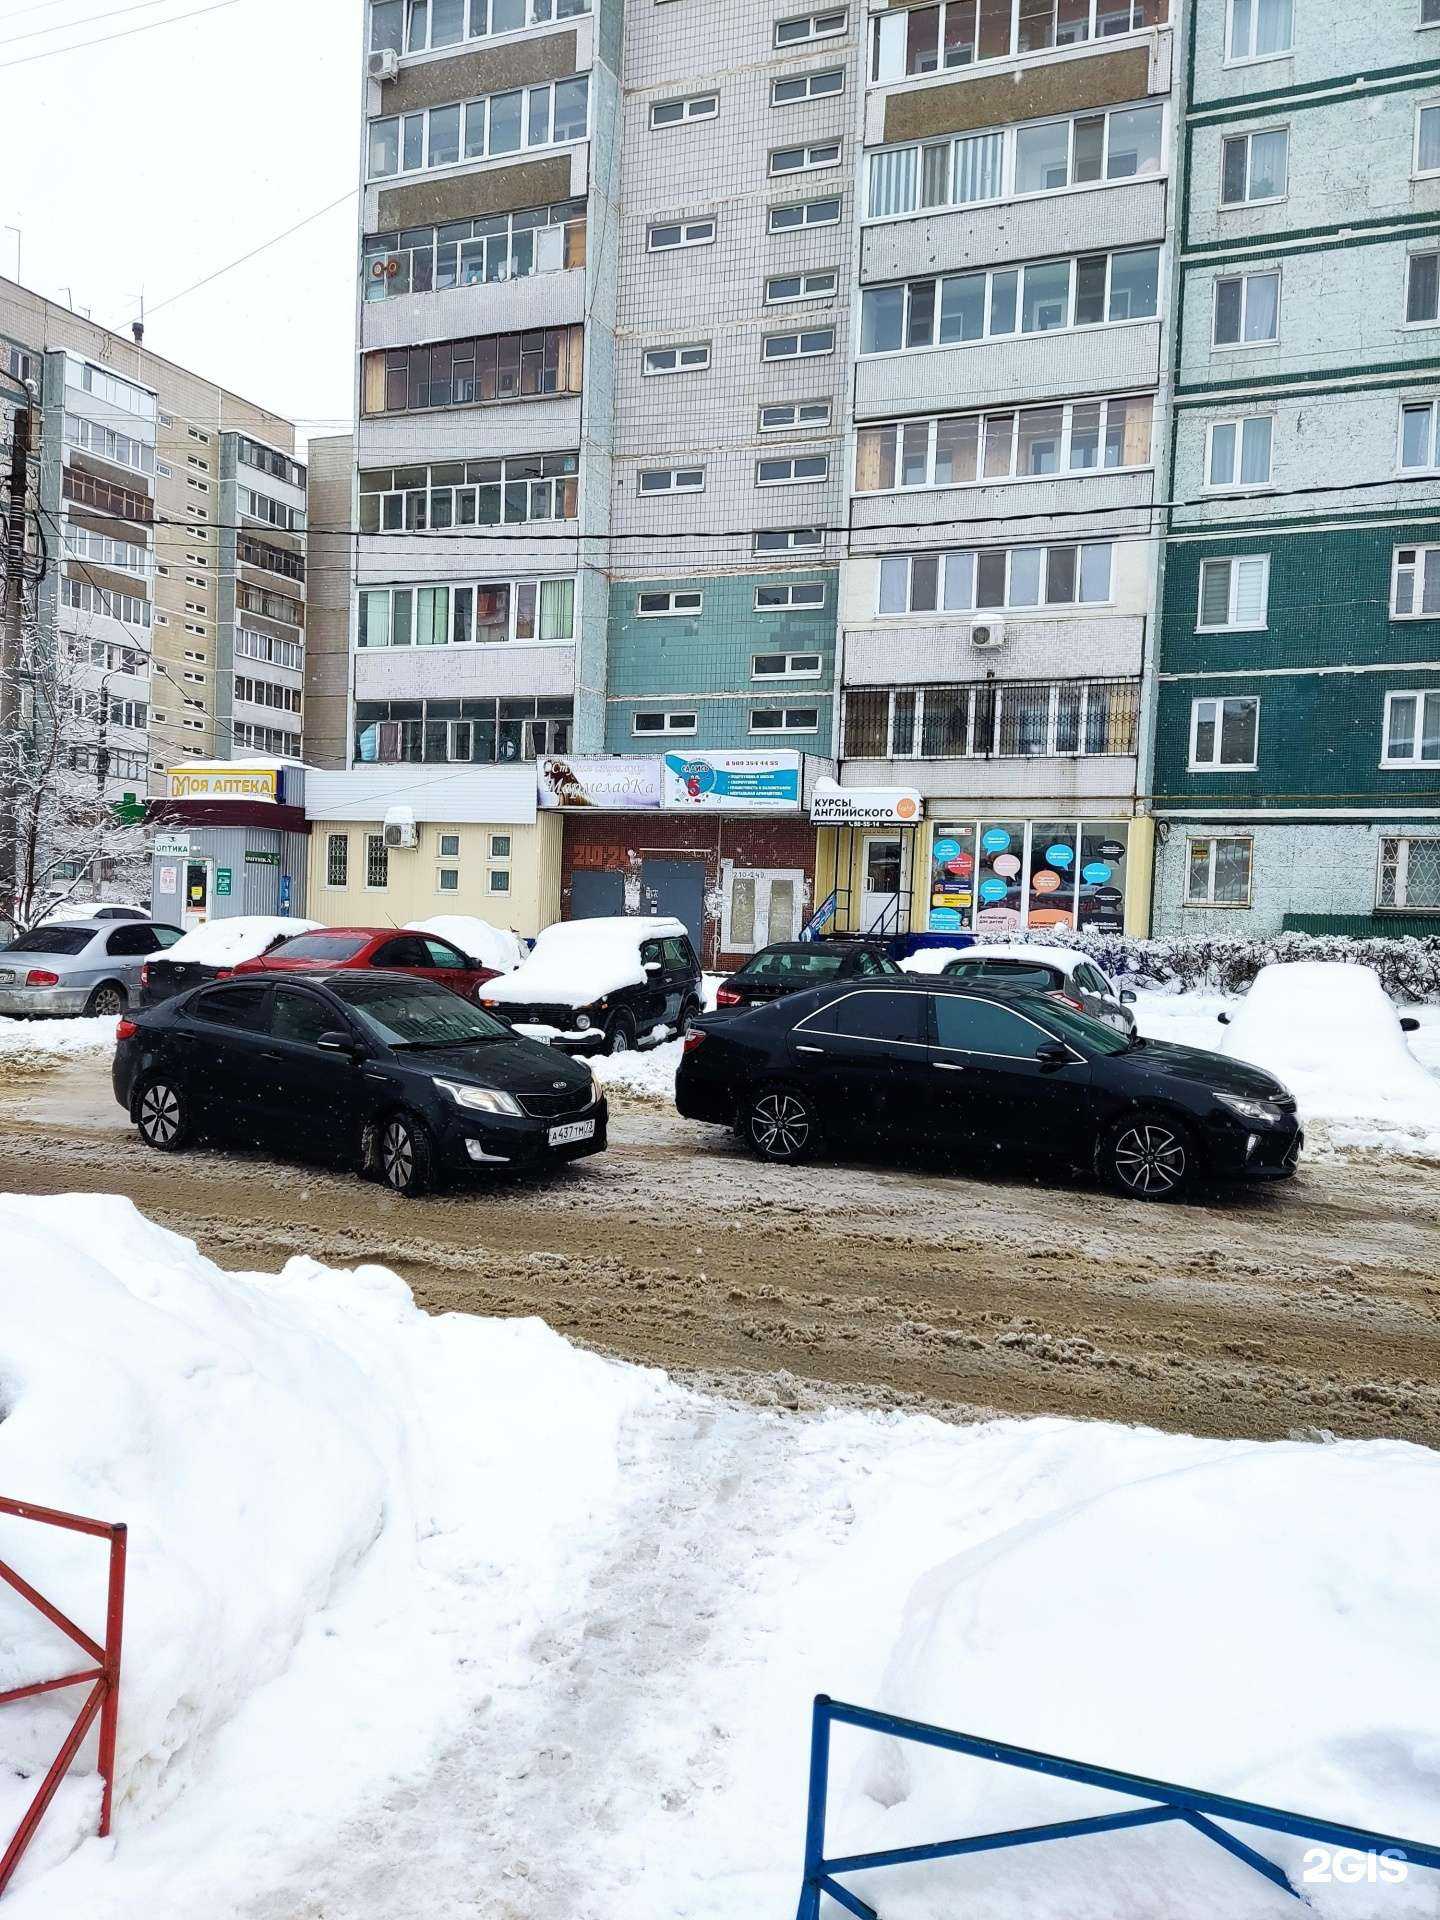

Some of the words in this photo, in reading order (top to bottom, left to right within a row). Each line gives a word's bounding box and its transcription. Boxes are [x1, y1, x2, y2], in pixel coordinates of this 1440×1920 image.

[172, 776, 209, 797] МОЯ
[213, 779, 270, 793] АПТЕКА
[814, 798, 852, 807] КУРСЫ
[814, 806, 894, 817] АНГЛИЙСКОГО
[156, 845, 188, 853] ОПТИКА
